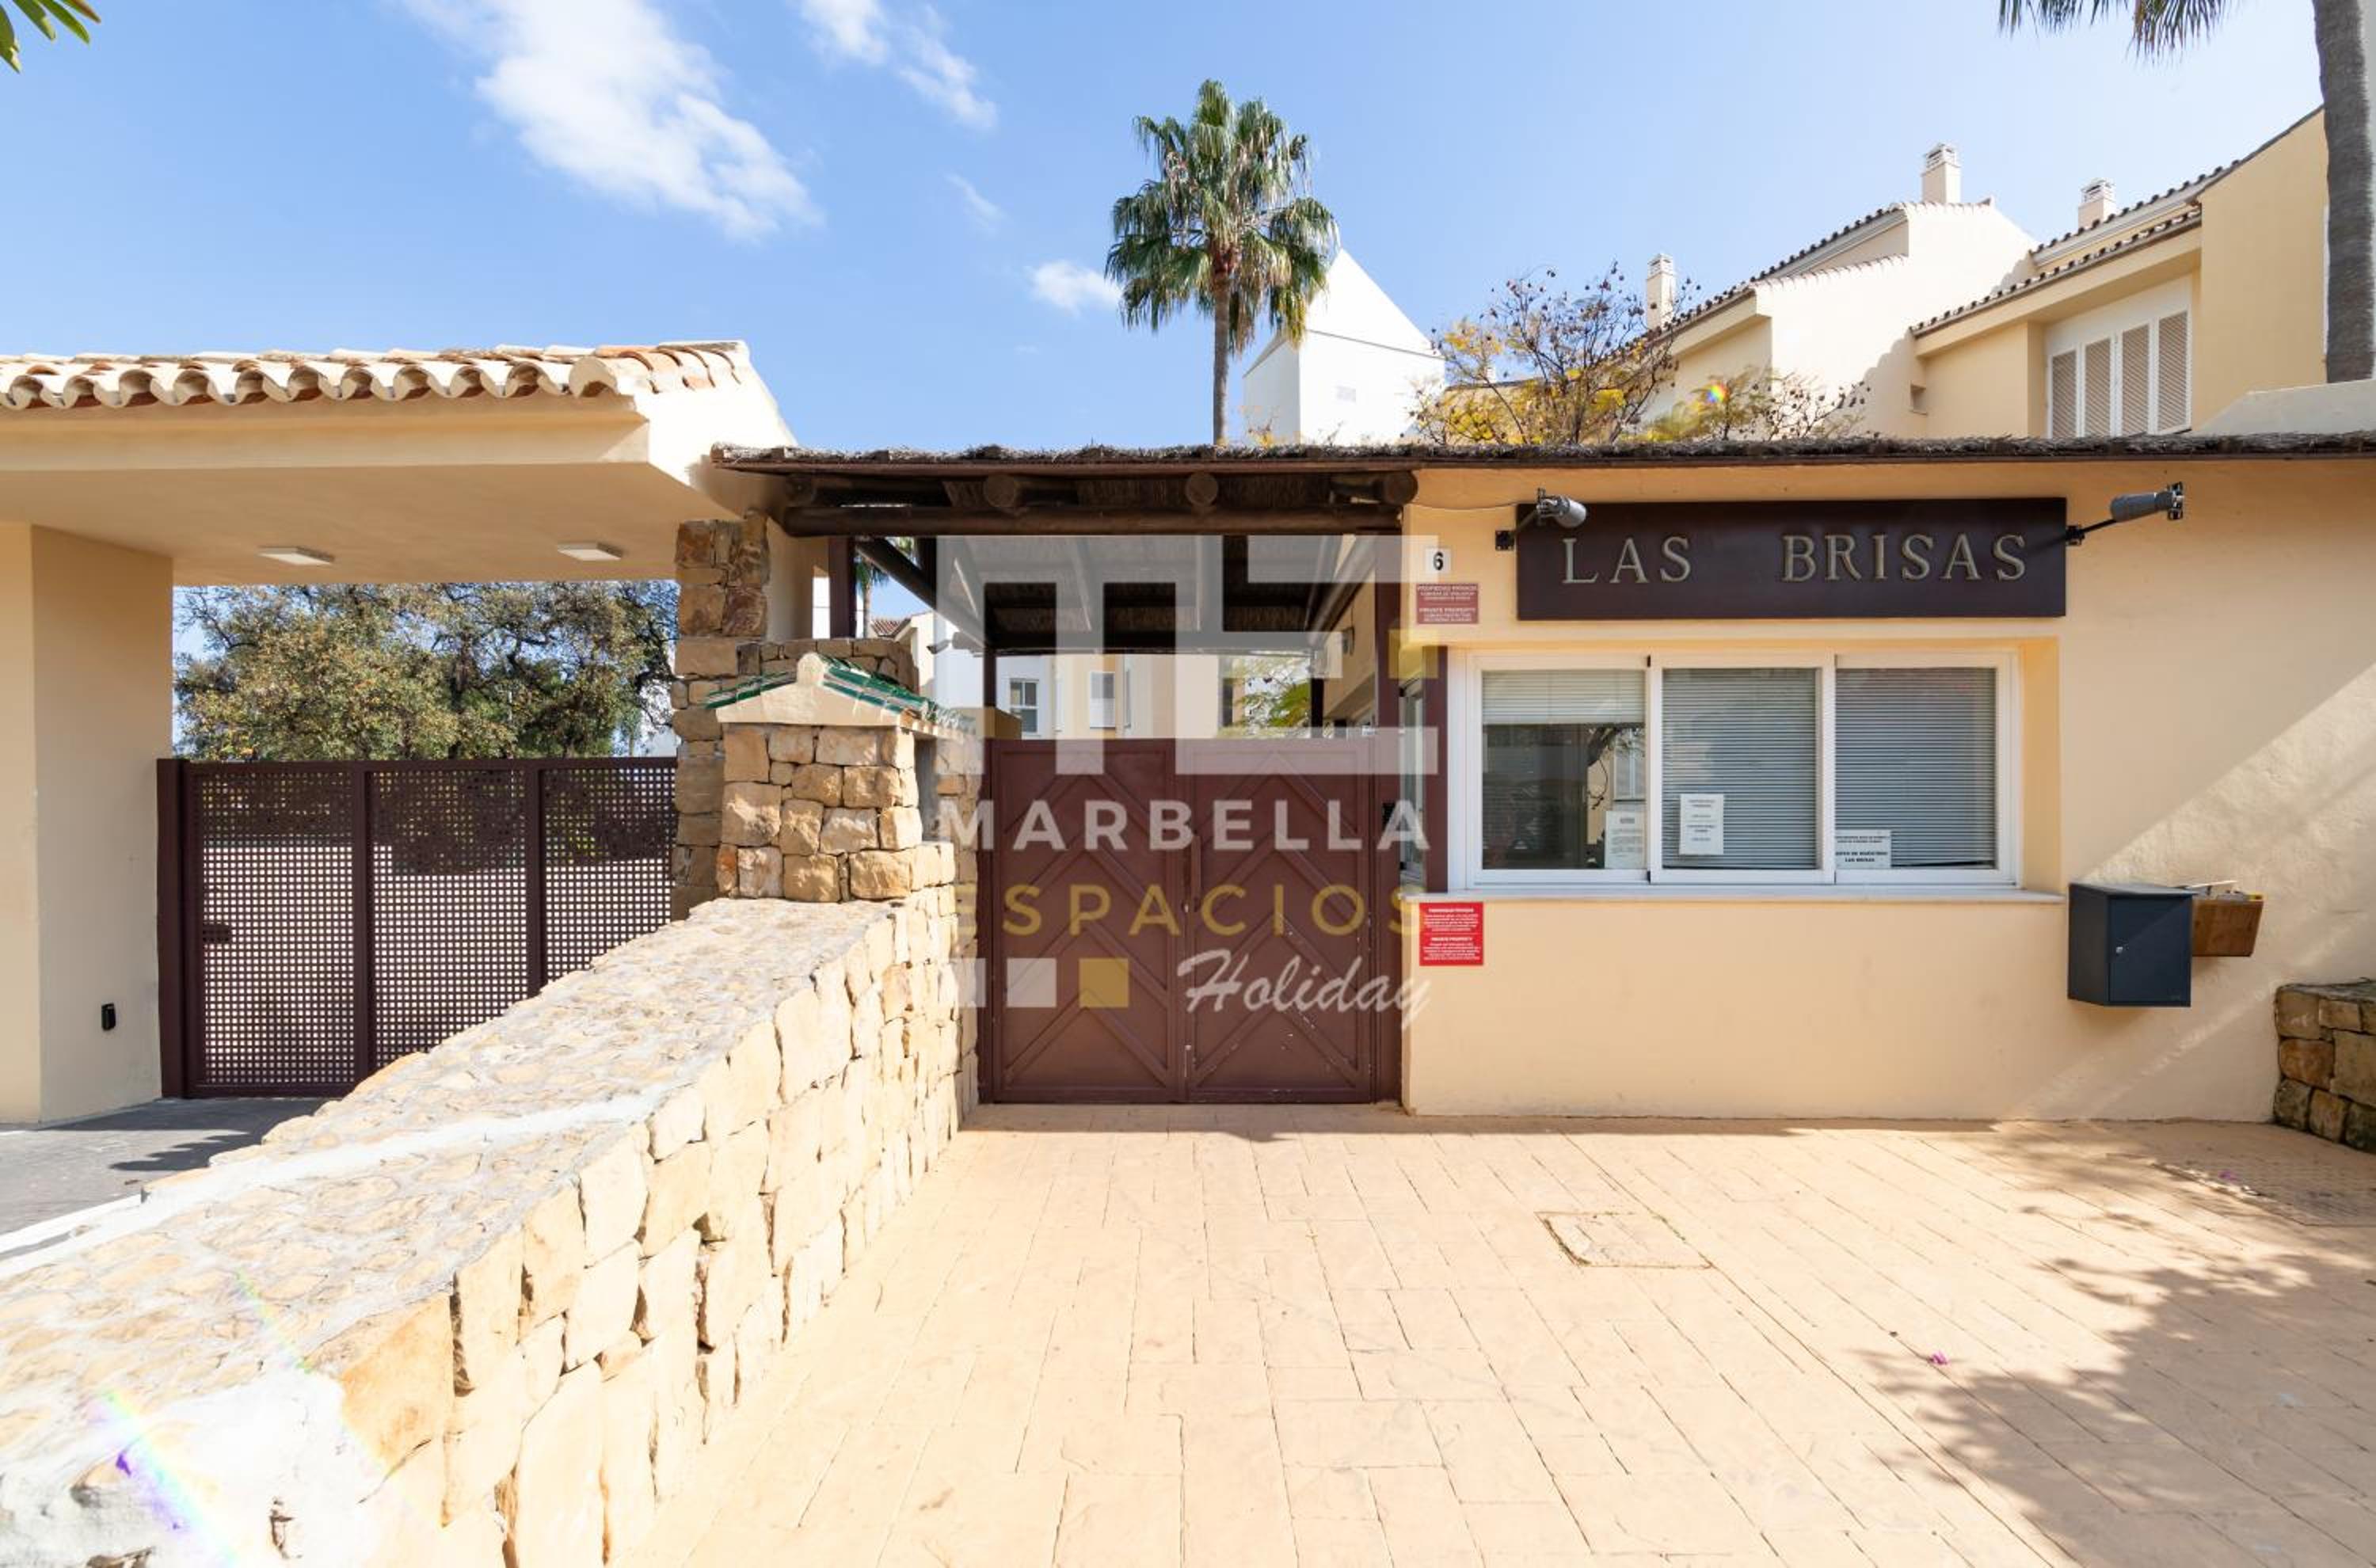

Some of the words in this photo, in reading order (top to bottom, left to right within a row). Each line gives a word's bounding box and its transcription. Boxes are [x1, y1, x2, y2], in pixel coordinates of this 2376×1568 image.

[1433, 551, 1444, 571] 6
[1562, 536, 1693, 584] LAS
[1781, 533, 2026, 583] BRISAS
